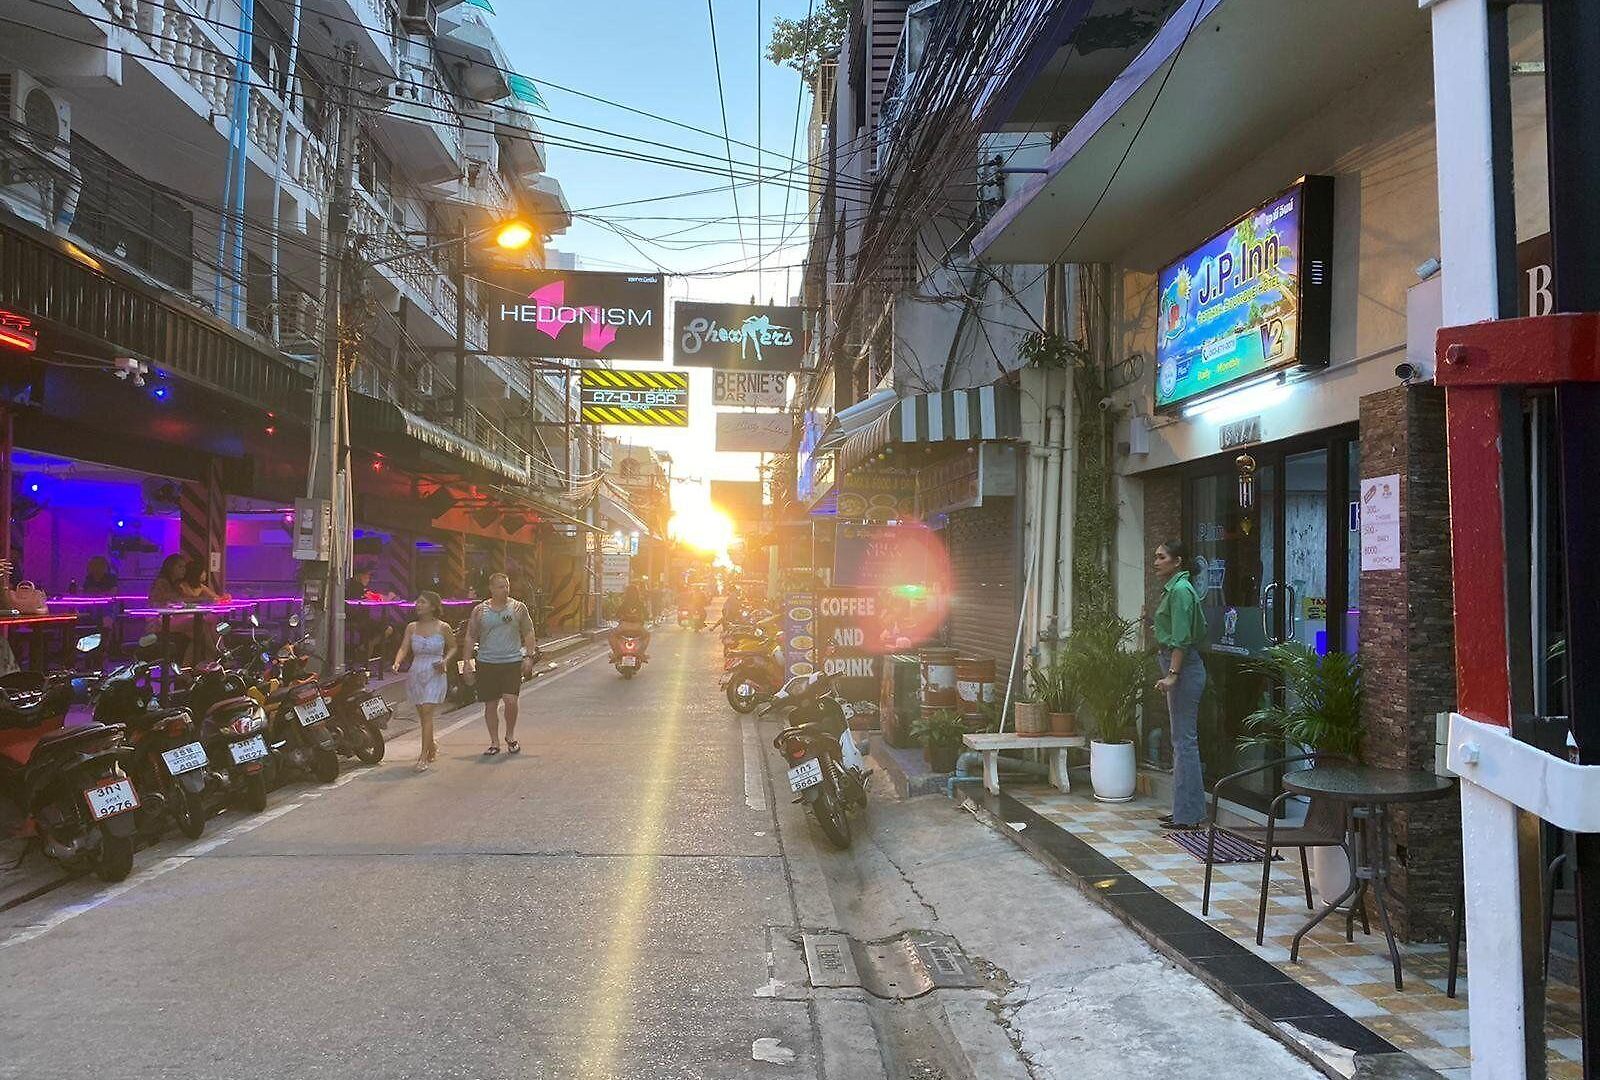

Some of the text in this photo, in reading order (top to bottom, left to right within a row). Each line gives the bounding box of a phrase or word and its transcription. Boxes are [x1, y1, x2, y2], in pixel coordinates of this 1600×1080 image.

[500, 304, 652, 327] HEDONISM
[715, 371, 785, 398] BERNIE'S
[645, 393, 677, 404] BAR
[820, 597, 875, 618] COFFEE
[833, 628, 865, 647] AND
[100, 799, 133, 816] 9276
